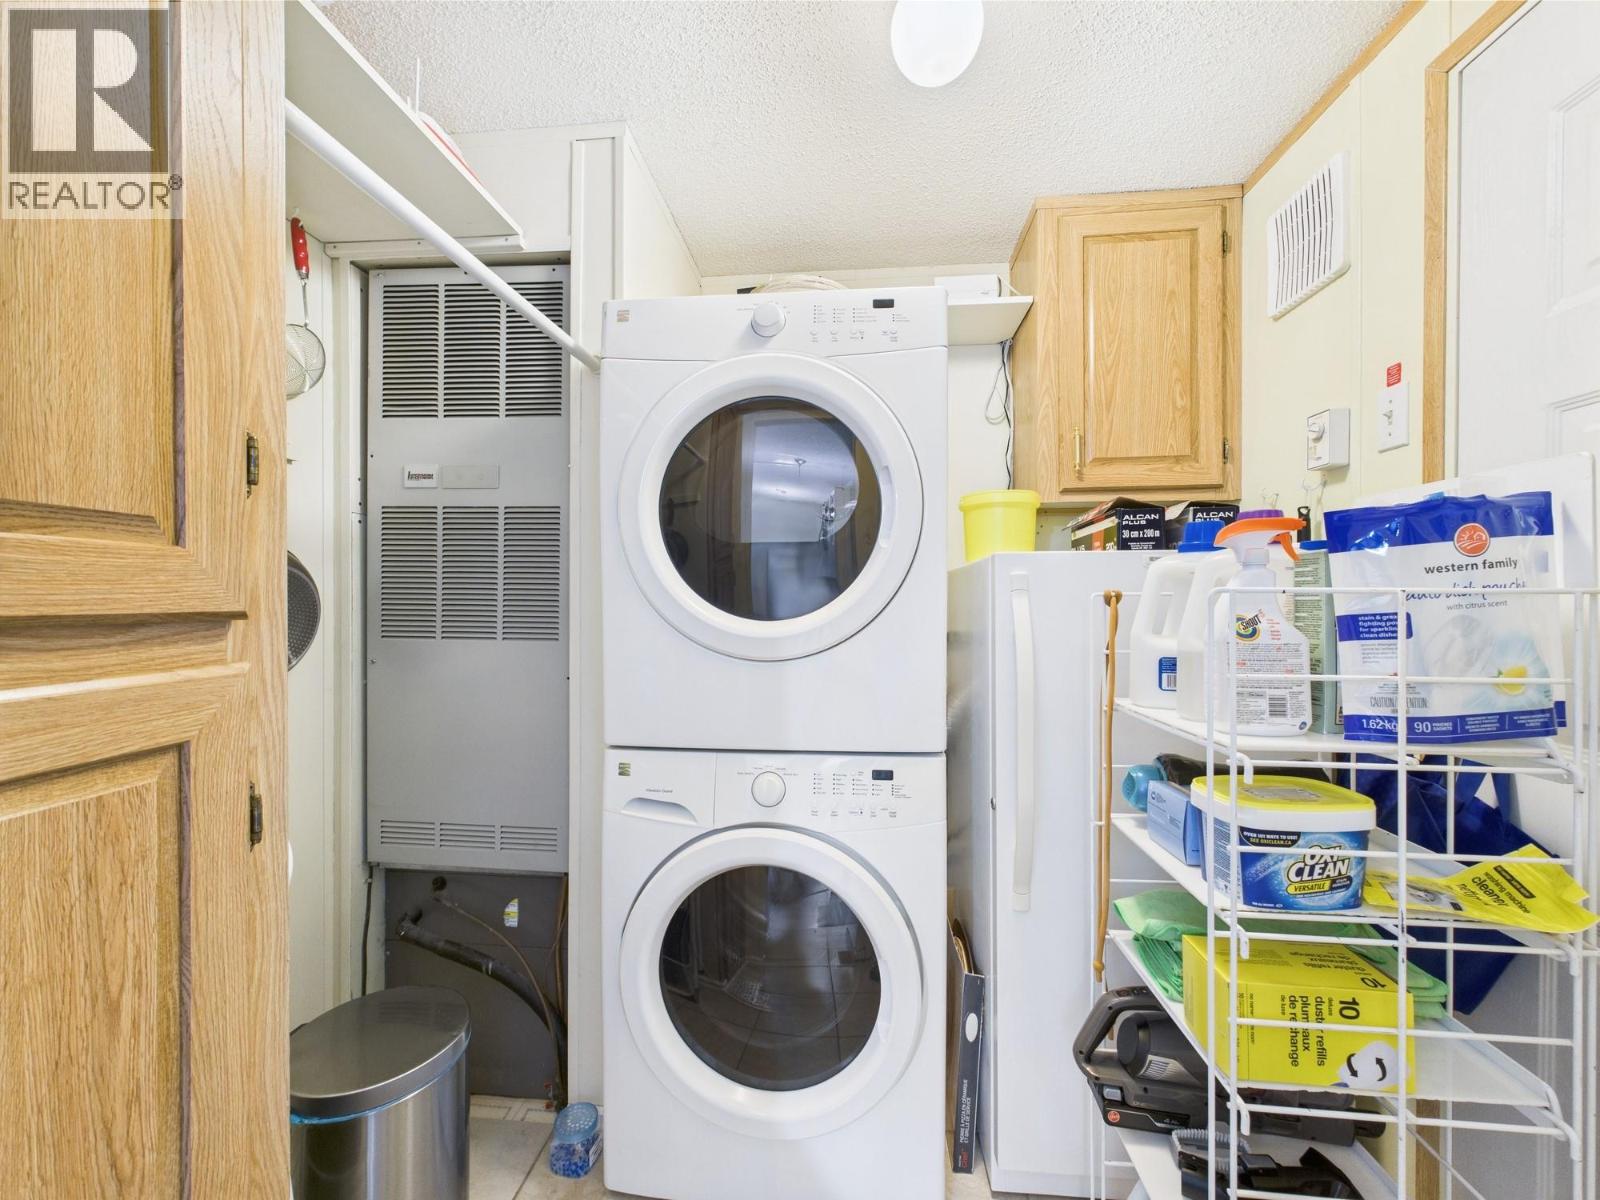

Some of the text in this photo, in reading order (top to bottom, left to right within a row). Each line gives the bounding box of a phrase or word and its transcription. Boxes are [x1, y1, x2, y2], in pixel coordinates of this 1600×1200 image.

[1122, 513, 1160, 521] ALCAN
[1122, 529, 1130, 538] 30
[1424, 557, 1518, 574] western family
[1465, 601, 1486, 609] citrus
[1487, 600, 1508, 608] scent
[1361, 719, 1383, 730] 1.62
[1414, 722, 1431, 733] 90
[1288, 859, 1350, 882] CLEAN
[1294, 882, 1326, 892] VERSATILE
[1288, 995, 1297, 1009] de
[1338, 997, 1360, 1020] 10
[1315, 996, 1328, 1067] dustr refills
